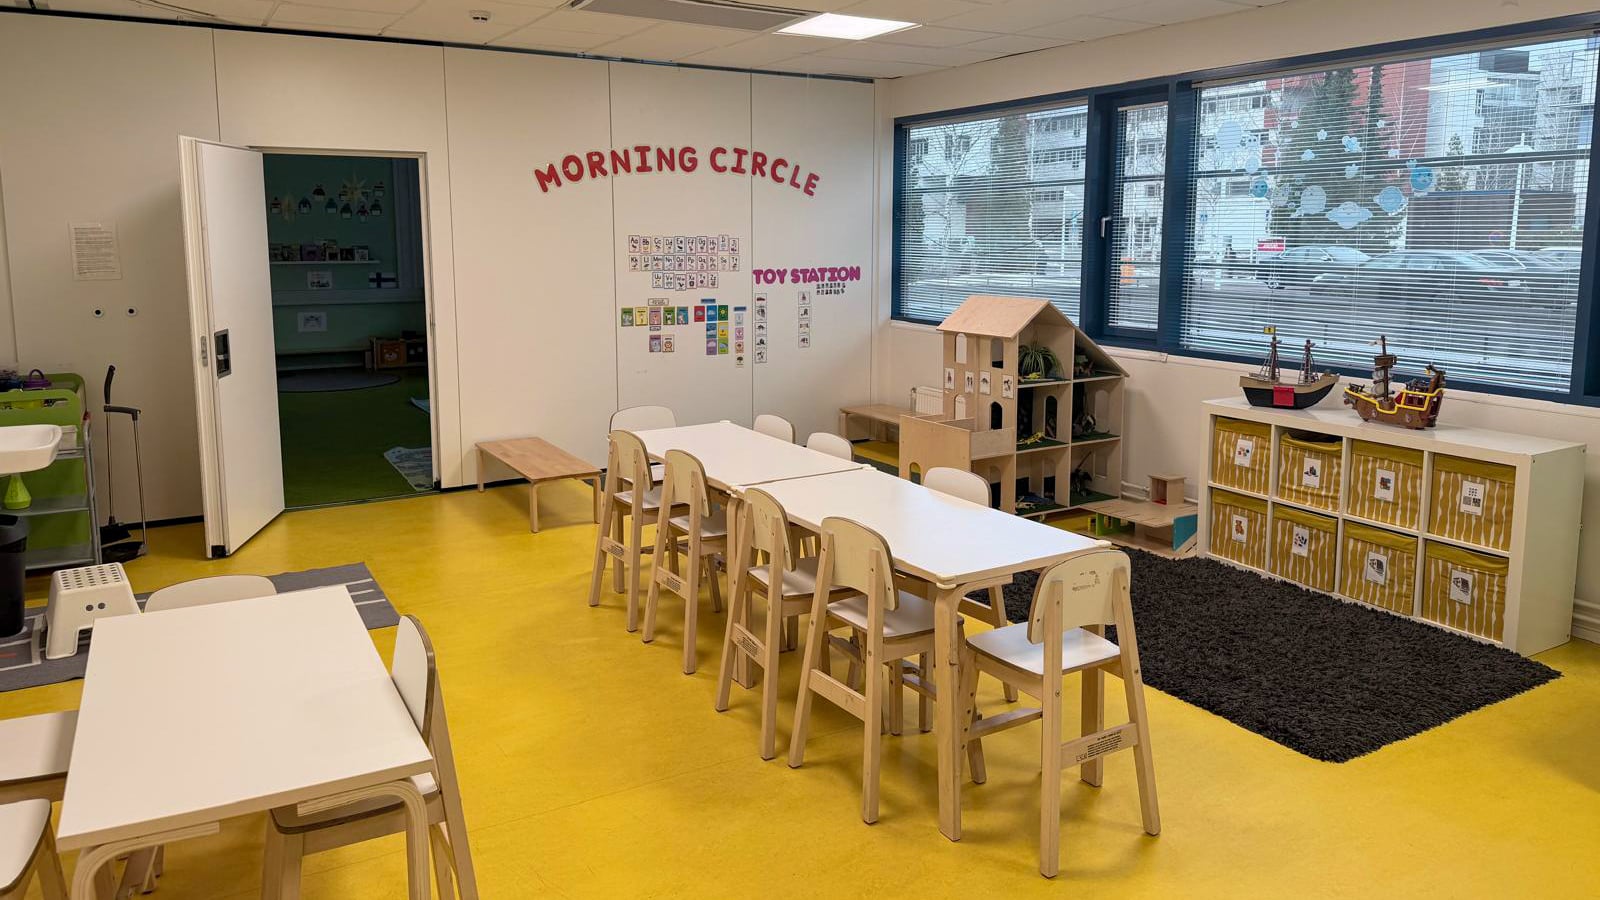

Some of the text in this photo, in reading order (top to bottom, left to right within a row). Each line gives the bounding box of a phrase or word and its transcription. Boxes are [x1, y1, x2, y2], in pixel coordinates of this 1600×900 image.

[534, 145, 820, 197] MORNING CIRCLE
[752, 265, 861, 285] TOY STATION
